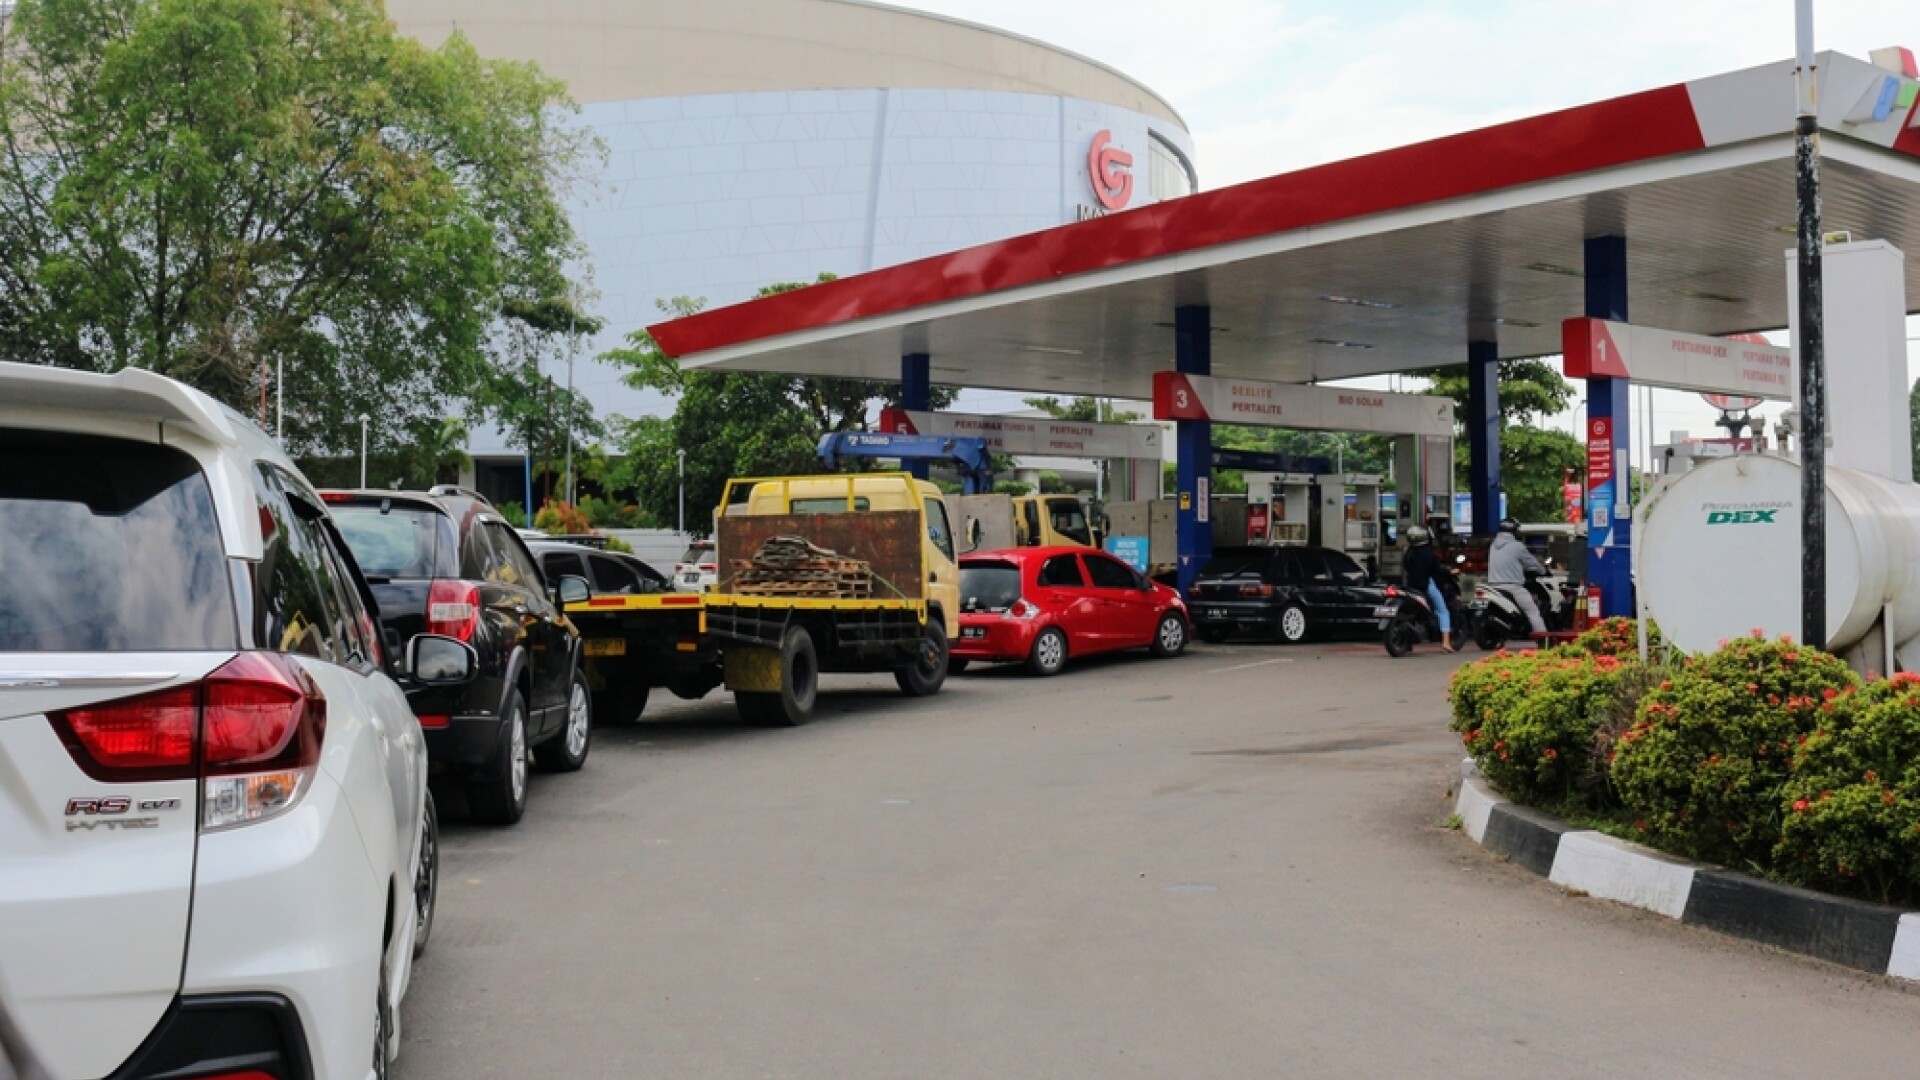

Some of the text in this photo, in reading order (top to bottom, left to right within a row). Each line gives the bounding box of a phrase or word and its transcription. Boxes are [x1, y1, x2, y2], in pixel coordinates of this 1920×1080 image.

[1596, 339, 1607, 362] 1
[1176, 389, 1188, 409] 3
[1232, 385, 1272, 399] DEXLITE
[1232, 401, 1282, 416] PERTALITE
[1337, 395, 1384, 408] BIO SOLAR
[955, 419, 1002, 432] PERTAMAX
[1050, 426, 1094, 438] PERTALITE
[1706, 509, 1779, 525] DEX
[65, 795, 131, 815] RS
